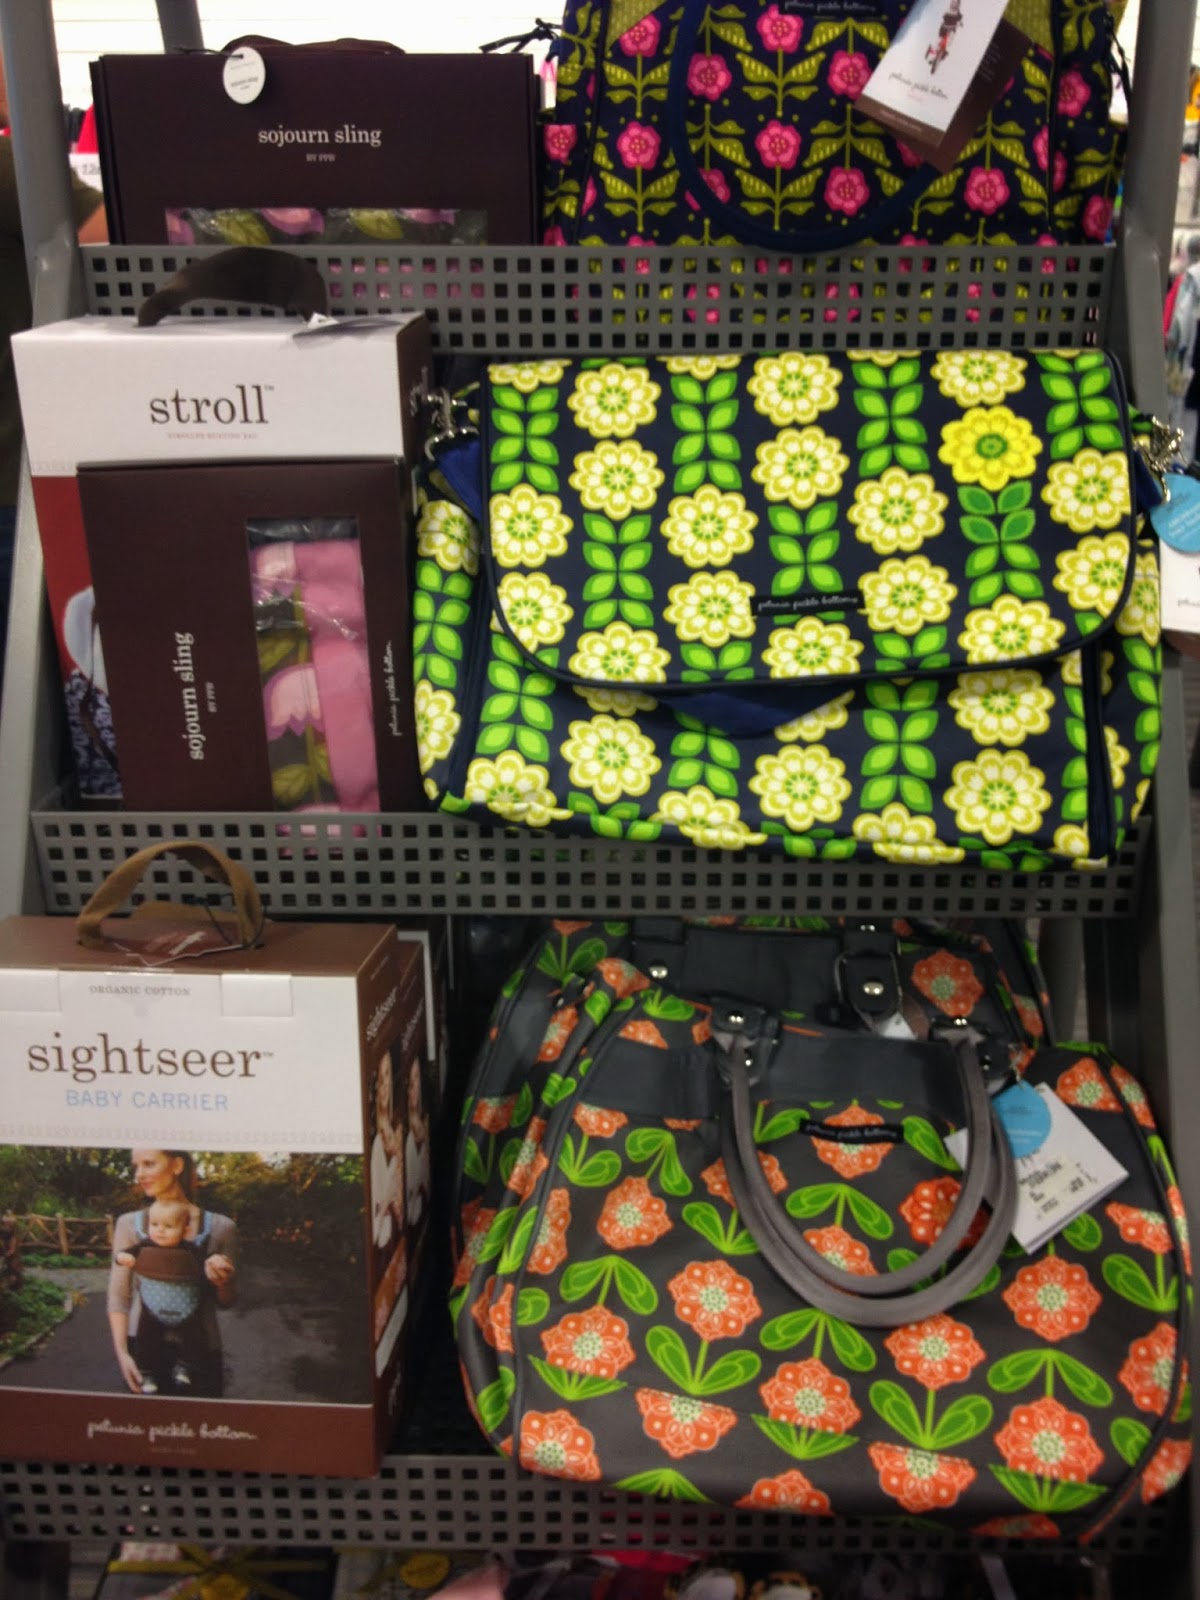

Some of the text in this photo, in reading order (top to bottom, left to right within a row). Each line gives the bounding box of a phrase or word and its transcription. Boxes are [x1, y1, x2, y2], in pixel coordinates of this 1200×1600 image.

[258, 123, 382, 148] sojourn sling
[172, 631, 207, 761] sojourn sling
[88, 984, 191, 997] ORGANIC COTTON
[65, 1088, 230, 1112] BABY CARRIER
[86, 1418, 145, 1439] petunia
[149, 1421, 196, 1443] pickle
